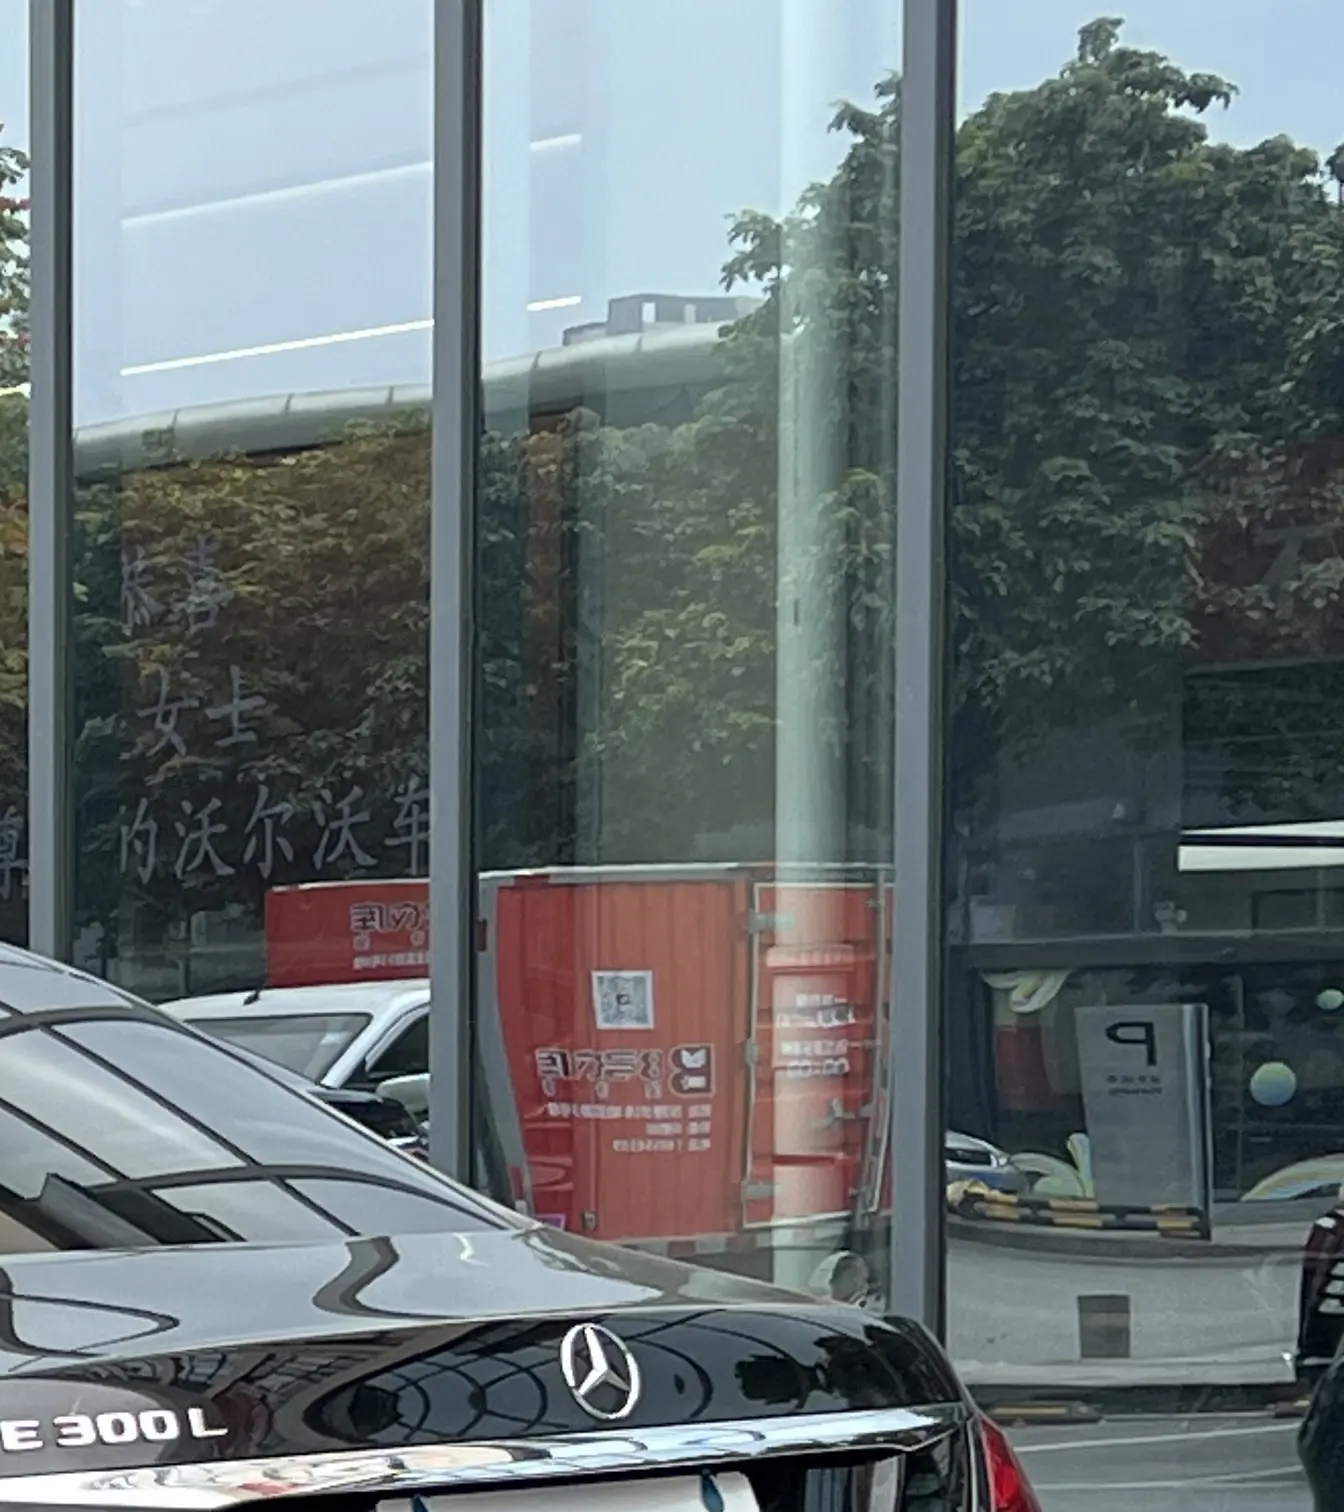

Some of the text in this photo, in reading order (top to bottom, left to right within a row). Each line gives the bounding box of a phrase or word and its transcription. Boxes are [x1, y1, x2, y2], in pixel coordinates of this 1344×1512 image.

[138, 665, 268, 758] 女士
[53, 1409, 181, 1447] 300
[187, 1406, 229, 1438] L
